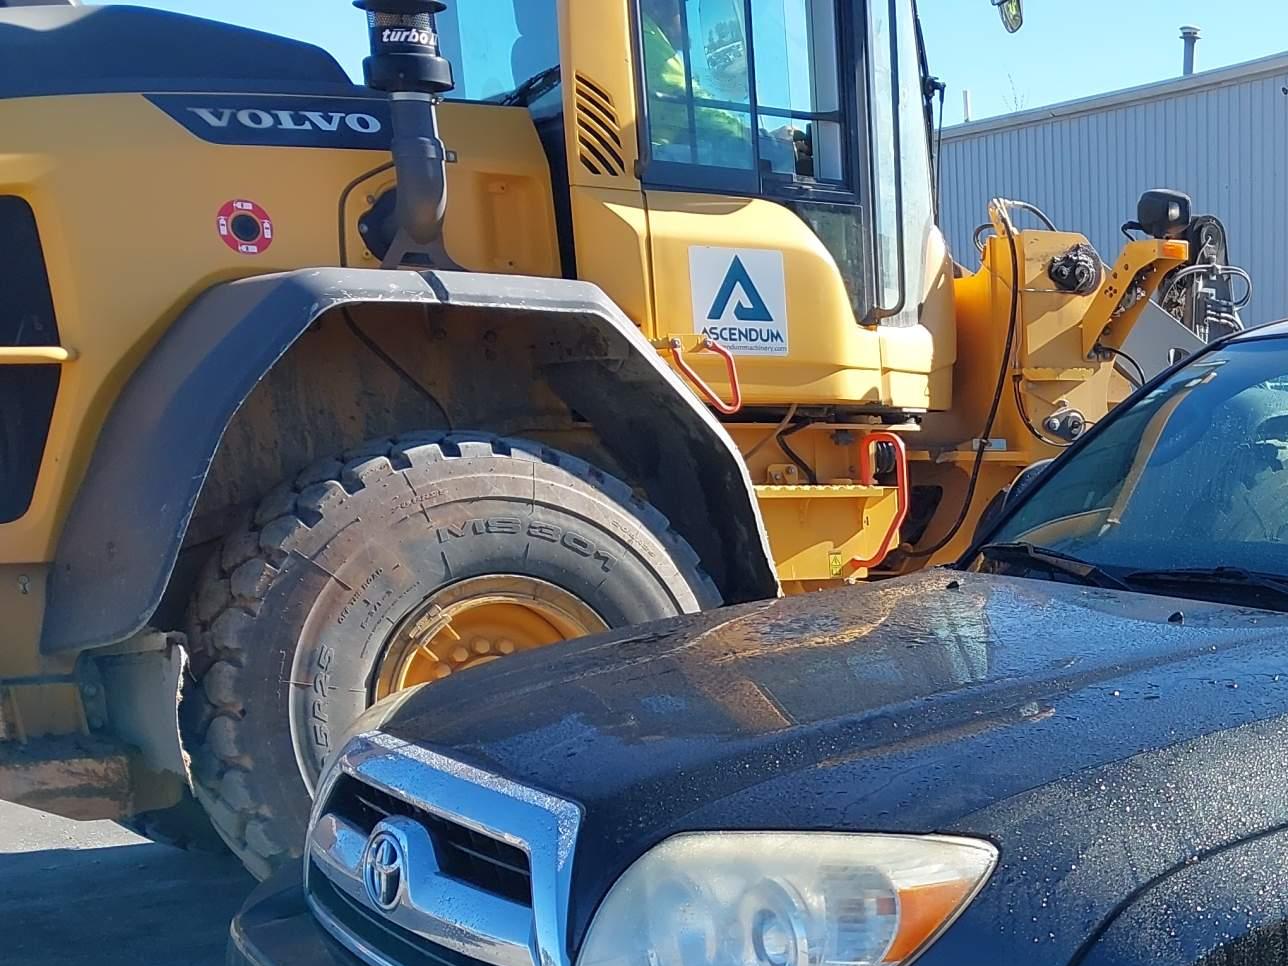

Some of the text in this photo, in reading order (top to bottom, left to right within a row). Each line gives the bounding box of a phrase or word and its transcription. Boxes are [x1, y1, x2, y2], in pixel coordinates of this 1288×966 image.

[382, 28, 429, 44] turbo
[186, 107, 382, 133] VOLVO
[702, 327, 784, 342] ASCENDUM
